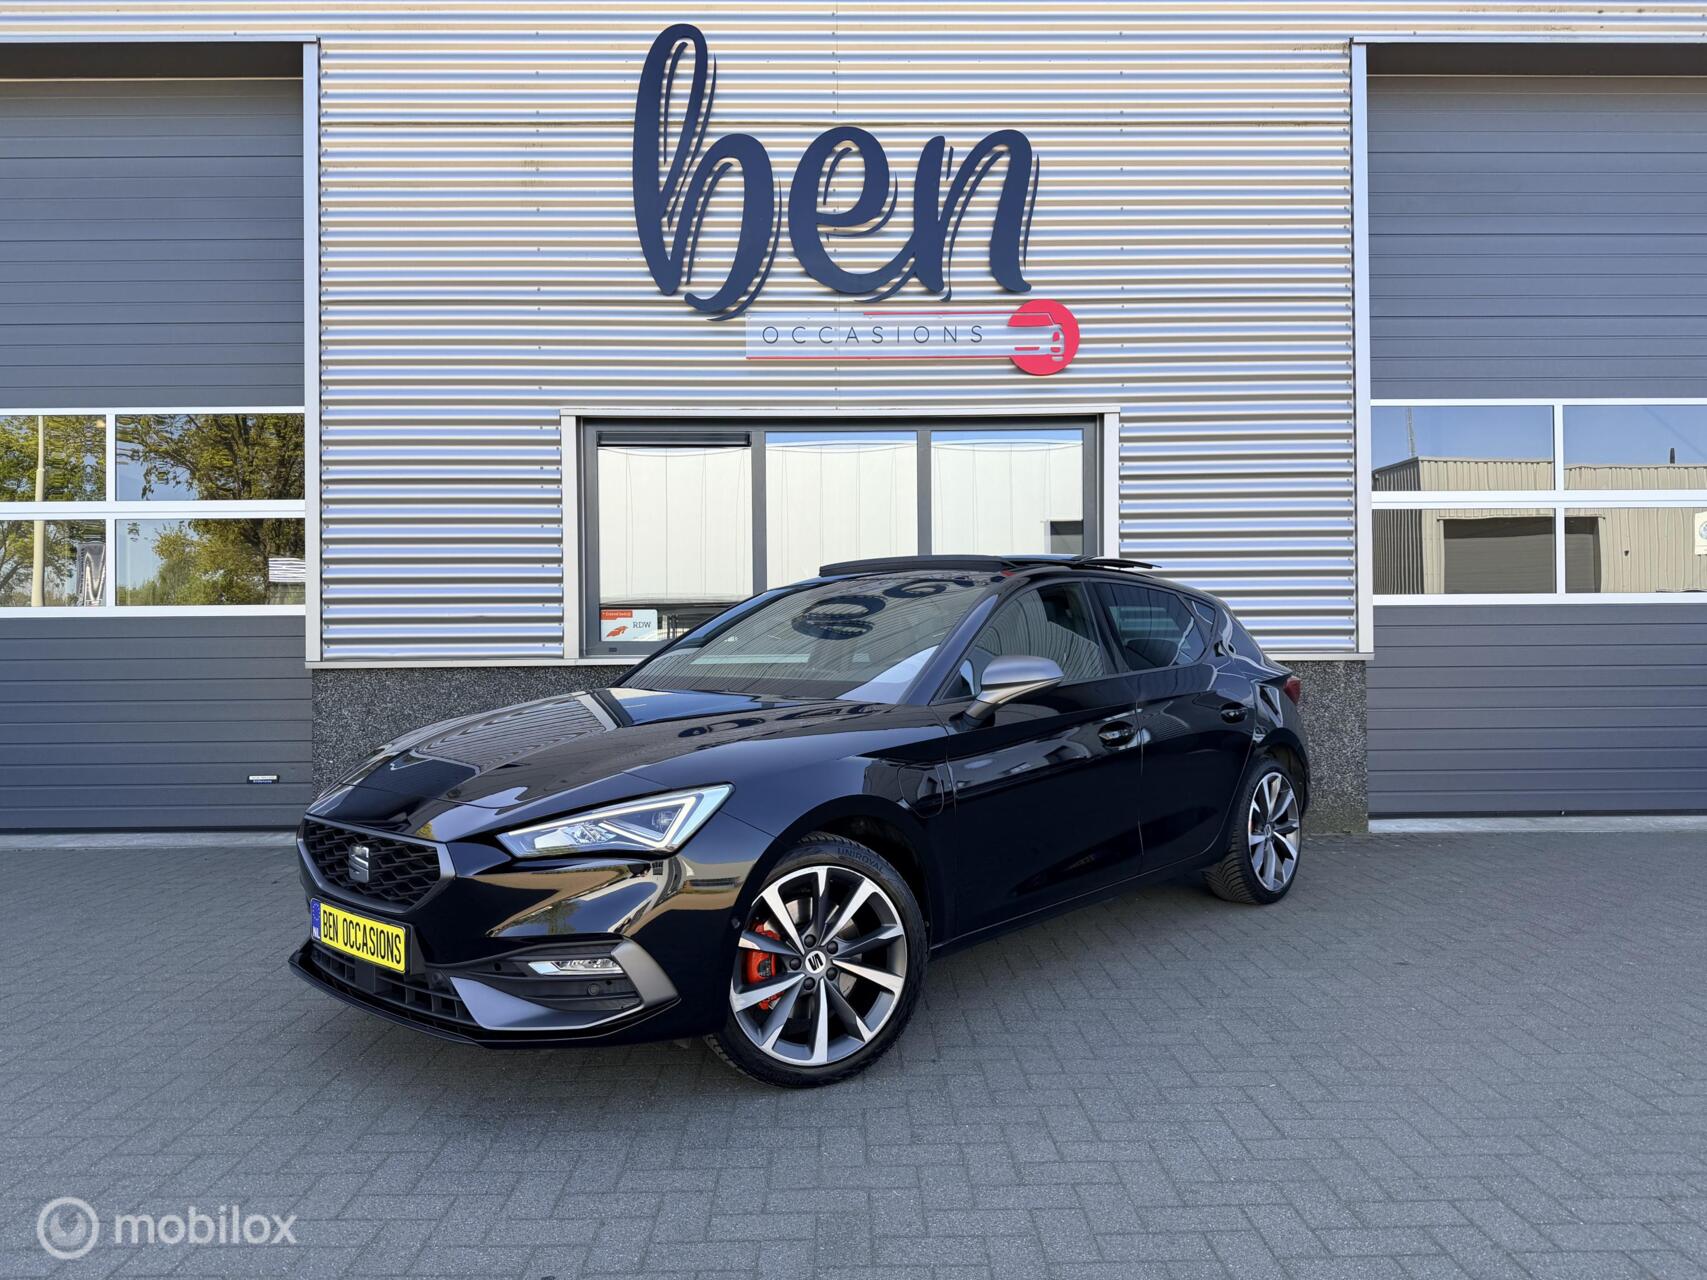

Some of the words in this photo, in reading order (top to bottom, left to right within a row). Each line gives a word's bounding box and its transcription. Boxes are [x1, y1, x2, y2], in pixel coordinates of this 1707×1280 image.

[633, 23, 1039, 321] ben
[762, 325, 984, 344] OCCASIONS
[632, 621, 651, 629] RDW
[838, 847, 884, 873] UNIROYAL
[312, 926, 320, 939] NL
[323, 909, 339, 944] BEN
[342, 917, 402, 965] OCCASIONS
